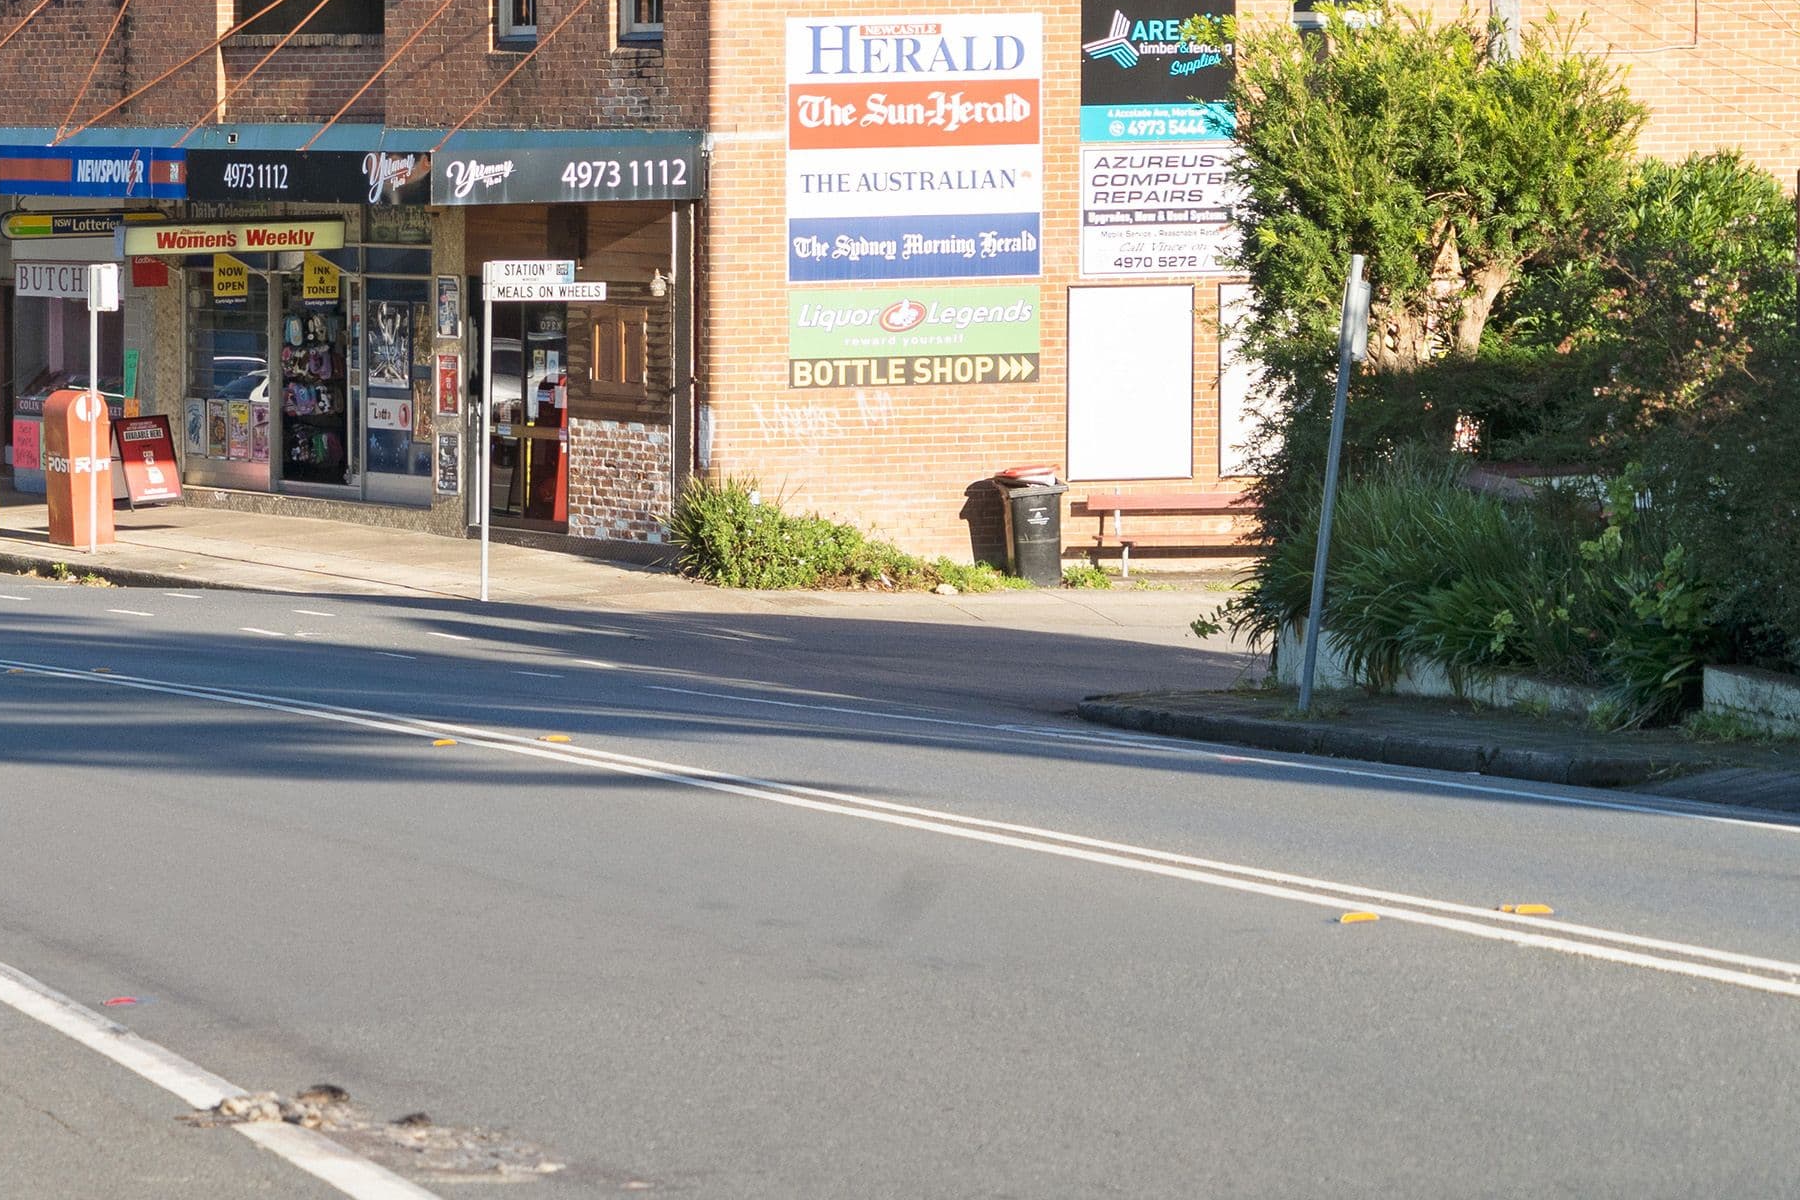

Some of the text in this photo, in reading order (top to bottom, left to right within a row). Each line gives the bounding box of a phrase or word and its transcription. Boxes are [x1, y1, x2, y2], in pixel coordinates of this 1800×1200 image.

[863, 24, 938, 36] NEWCASTLE
[1131, 20, 1197, 41] ARE
[805, 25, 1026, 75] HERALD
[1169, 53, 1222, 77] Supplies
[797, 91, 1031, 132] The Sun-Herald
[1127, 119, 1207, 136] 4973 5444
[1094, 155, 1215, 169] AZUREUS
[224, 163, 288, 189] 4973 1112
[446, 160, 515, 198] Yummy
[561, 159, 687, 188] 4973 1112
[800, 168, 1017, 194] THE AUSTRALIAN
[1093, 190, 1204, 204] REPAIRS
[54, 218, 72, 227] NSW
[157, 229, 315, 249] Women's Weekly
[793, 233, 1037, 263] The Sydney Morning Herald
[504, 263, 545, 276] STATION
[1114, 257, 1152, 268] 4970
[1158, 256, 1197, 267] 5272
[219, 266, 243, 277] NOW
[314, 266, 330, 275] INK
[19, 266, 123, 292] BUTCH
[217, 281, 245, 291] OPEN
[319, 276, 325, 284] &
[307, 285, 337, 294] TONER
[497, 285, 601, 298] MEALS ON WHEELS
[798, 298, 1033, 333] Liquor Legends
[844, 333, 964, 348] reward yourself
[793, 357, 994, 387] BOTTLE SHOP
[48, 457, 70, 473] POST
